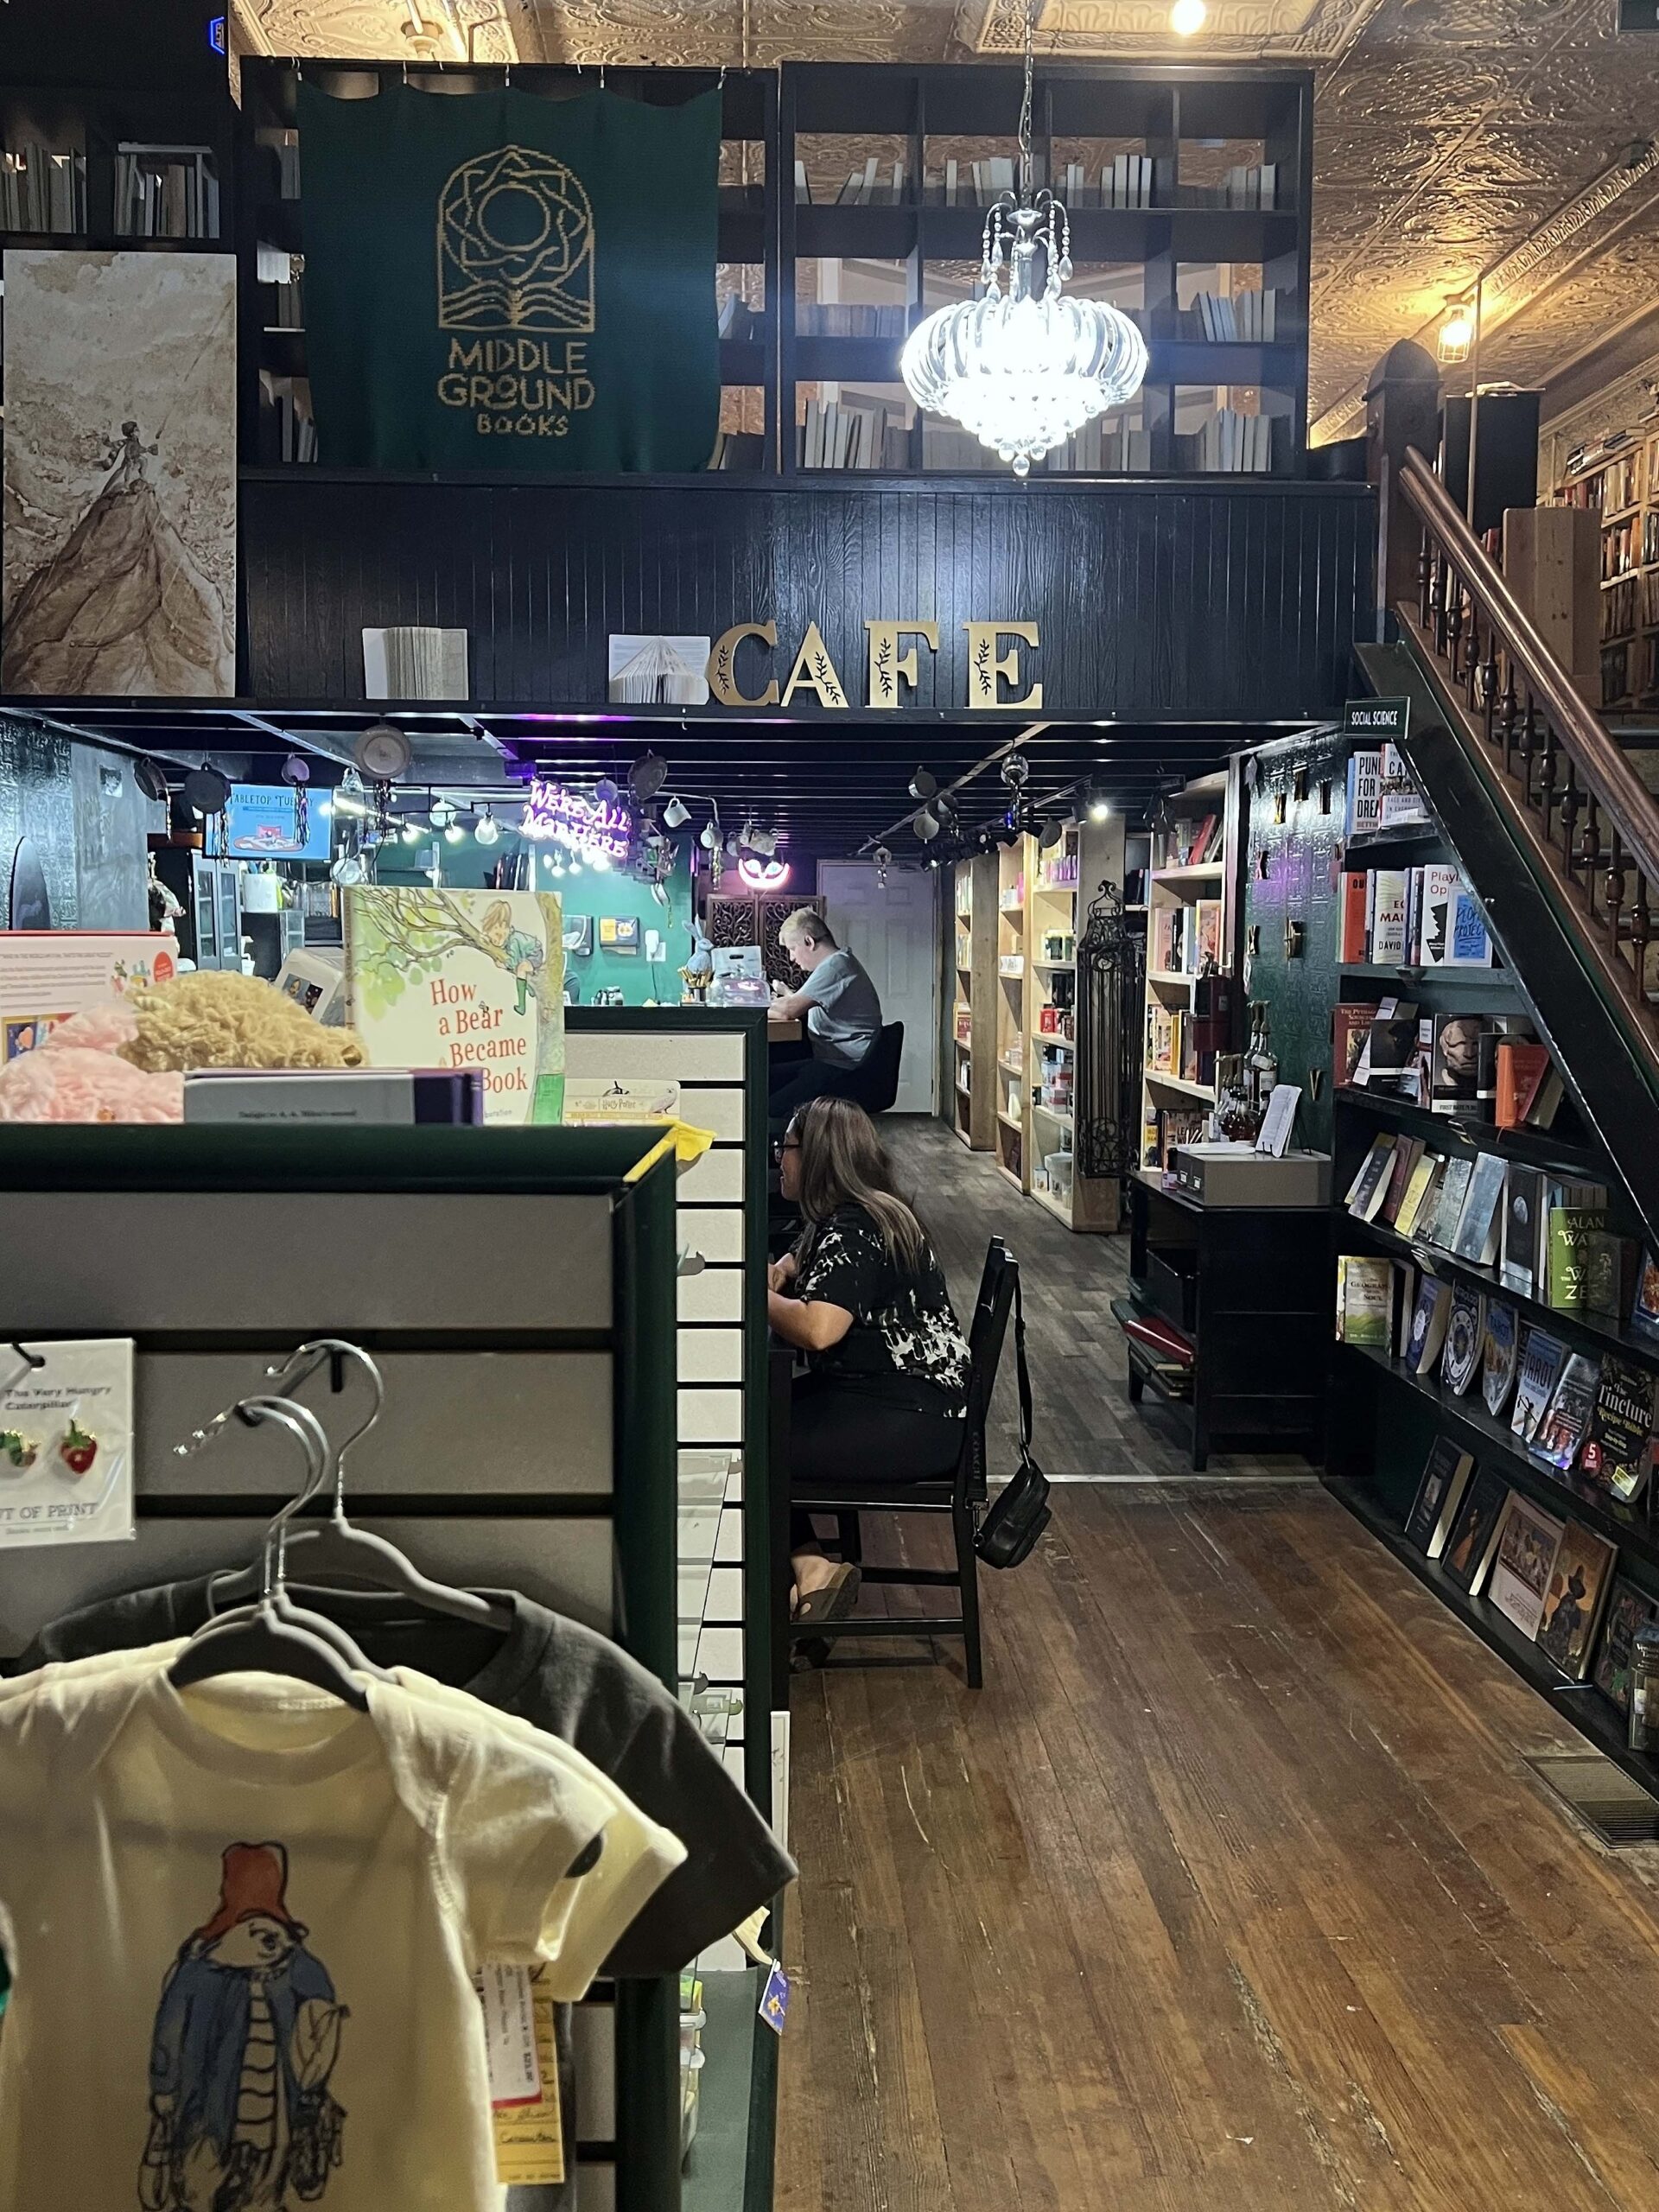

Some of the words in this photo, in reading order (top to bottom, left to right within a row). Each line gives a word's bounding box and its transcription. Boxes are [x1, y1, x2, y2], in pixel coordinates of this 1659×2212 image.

[448, 337, 588, 374] MIDDLE
[437, 373, 596, 410] GROUND
[477, 414, 569, 436] BOOKS
[707, 620, 1043, 709] CAFE
[1351, 711, 1371, 726] SOCIAL
[1372, 711, 1398, 726] SCIENCE
[1389, 761, 1407, 776] CA
[1358, 778, 1376, 797] FOR
[1378, 941, 1401, 950] DAVID
[430, 978, 477, 1006] How
[439, 1015, 450, 1035] a
[455, 1008, 504, 1034] Bear
[449, 1037, 527, 1068] Became
[482, 1066, 528, 1094] Book
[485, 1109, 512, 1119] boration
[1567, 1216, 1605, 1229] ALAN
[1523, 1351, 1554, 1390] TAROT
[4, 1389, 29, 1397] The
[33, 1388, 61, 1398] Very
[67, 1386, 111, 1397] Hungry
[5, 1400, 73, 1411] Caterpillar
[1598, 1383, 1652, 1428] Tincture
[1587, 1443, 1597, 1459] 5
[0, 1507, 16, 1521] T
[19, 1506, 41, 1520] OF
[48, 1502, 99, 1517] PRINT
